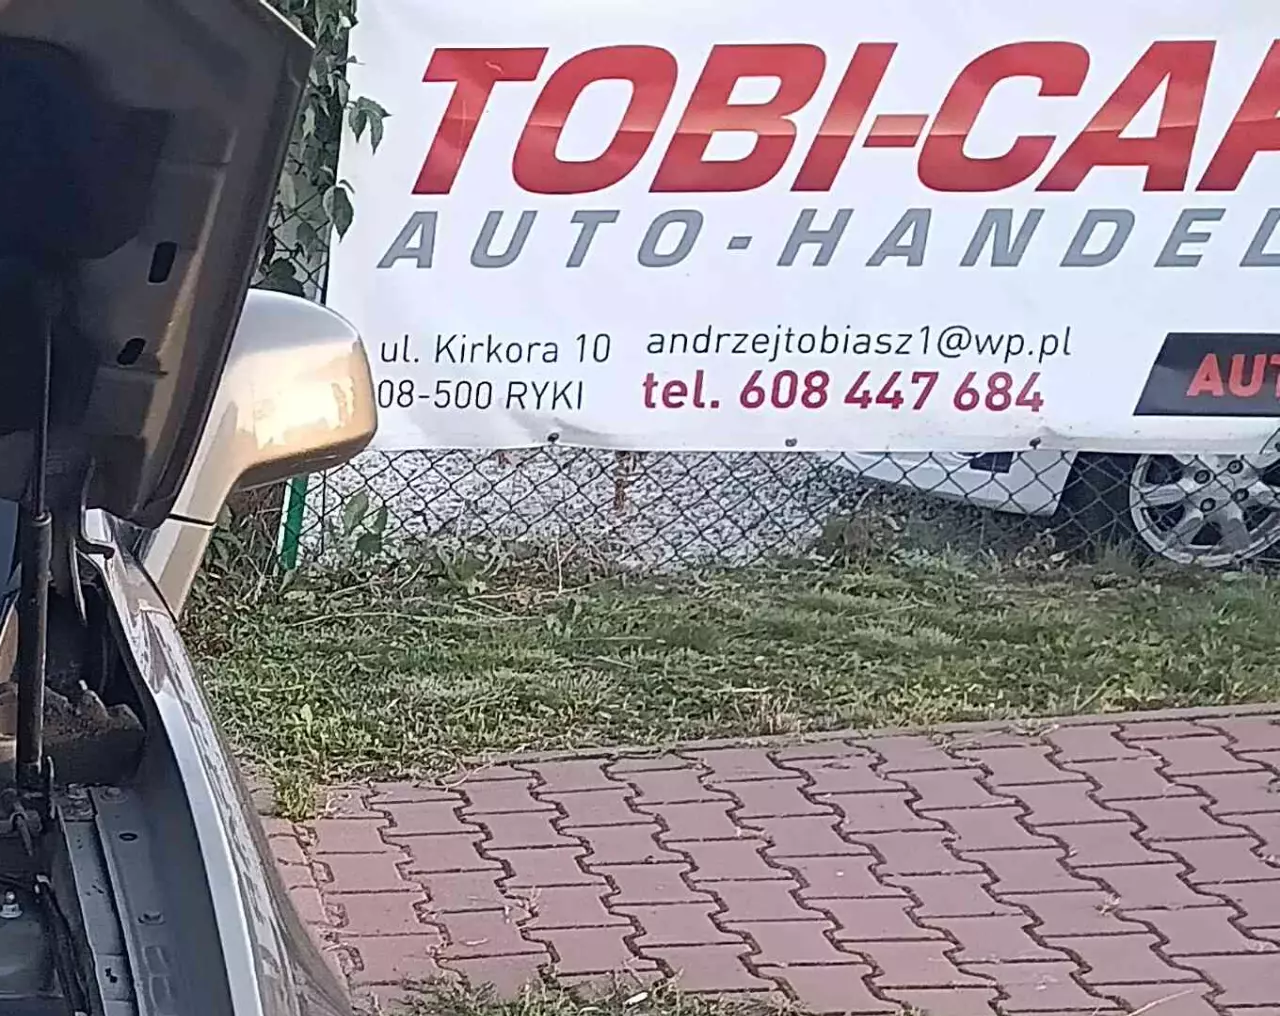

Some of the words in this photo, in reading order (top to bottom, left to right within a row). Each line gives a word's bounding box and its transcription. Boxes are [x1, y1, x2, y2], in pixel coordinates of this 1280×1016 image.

[380, 334, 419, 363] ul.
[434, 334, 559, 363] Kirkora
[575, 333, 611, 363] 10
[646, 325, 1072, 364] andrzejtobiasz1@wp.pl
[377, 379, 492, 410] 08-500
[505, 380, 583, 410] RYKI
[642, 369, 720, 409] tel.
[739, 369, 831, 409] 608
[844, 370, 939, 411] 447
[952, 371, 1045, 412] 684
